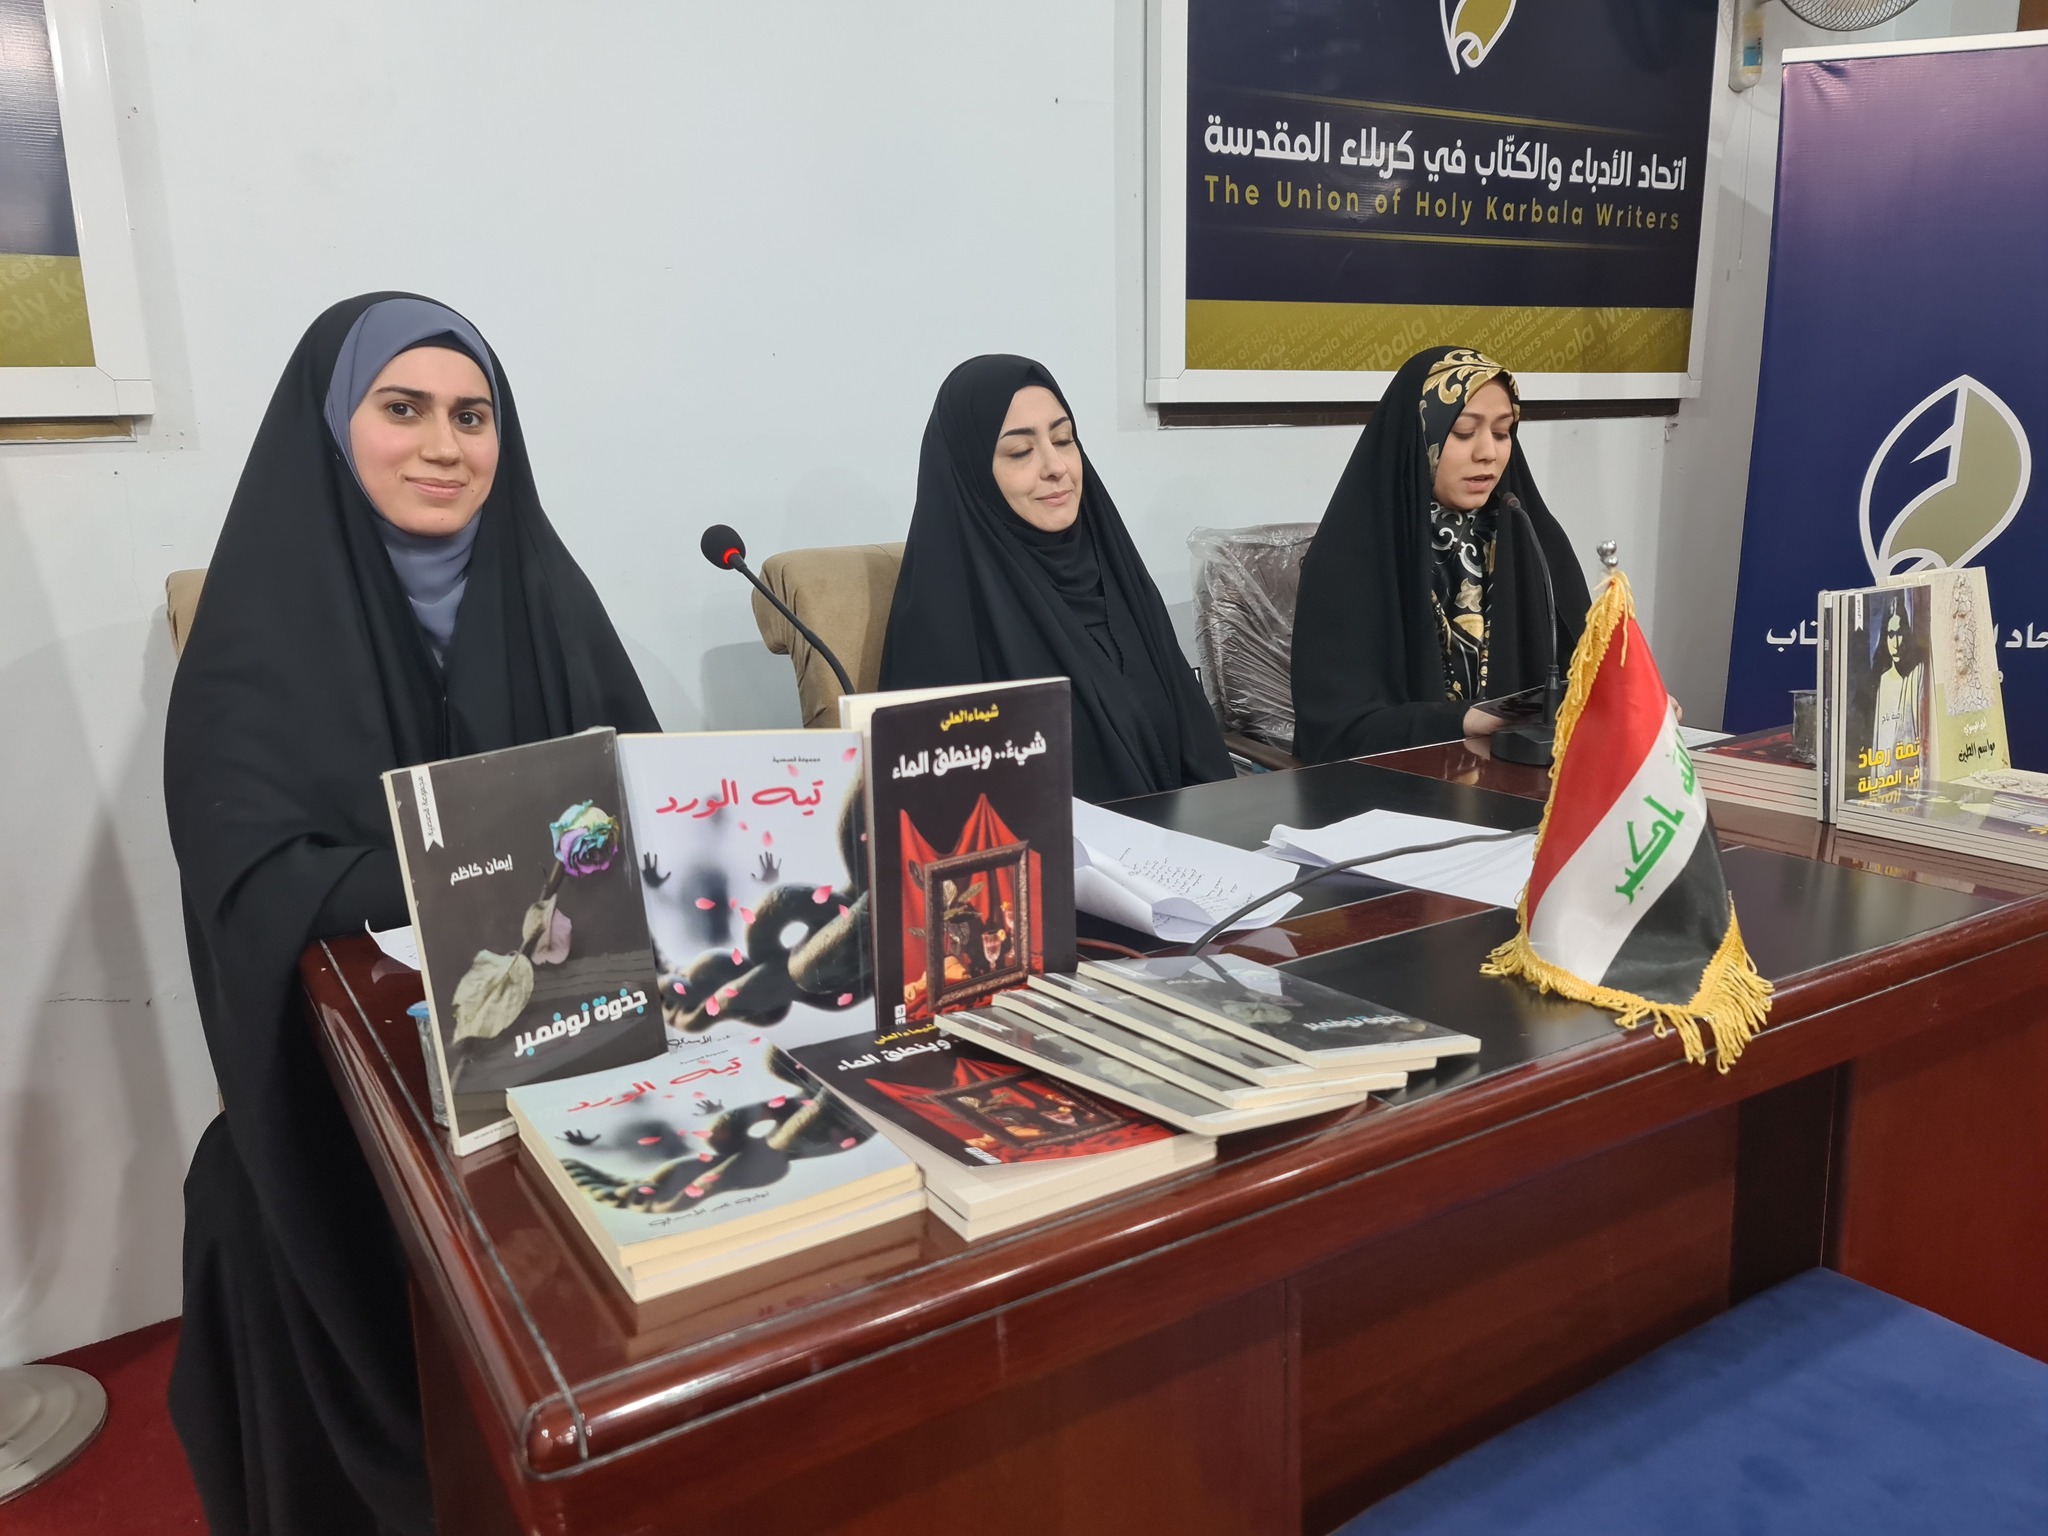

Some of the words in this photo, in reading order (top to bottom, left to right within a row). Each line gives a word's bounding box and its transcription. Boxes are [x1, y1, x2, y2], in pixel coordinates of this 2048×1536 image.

[1203, 114, 1332, 164] المقدسة
[1340, 127, 1415, 180] كربلاء
[1423, 139, 1467, 183] في
[1568, 147, 1633, 194] الأدباء
[1637, 154, 1688, 192] اتحاد
[1204, 174, 1260, 206] The
[1277, 180, 1360, 213] Union
[1375, 187, 1402, 215] of
[1416, 191, 1473, 226] Holy
[1486, 195, 1584, 226] Karbala
[1595, 203, 1680, 231] Writers
[891, 750, 930, 780] الماء
[932, 744, 993, 777] وينطق
[1894, 736, 1921, 761] ثمة
[655, 778, 740, 820] الورد
[752, 780, 825, 816] تيه
[1857, 768, 1903, 794] المدينة
[449, 863, 484, 887] كاظم
[594, 987, 649, 1022] جذوة
[512, 1002, 593, 1059] نوفمبر
[837, 1053, 881, 1072] الماء
[880, 1039, 952, 1062] وينطق
